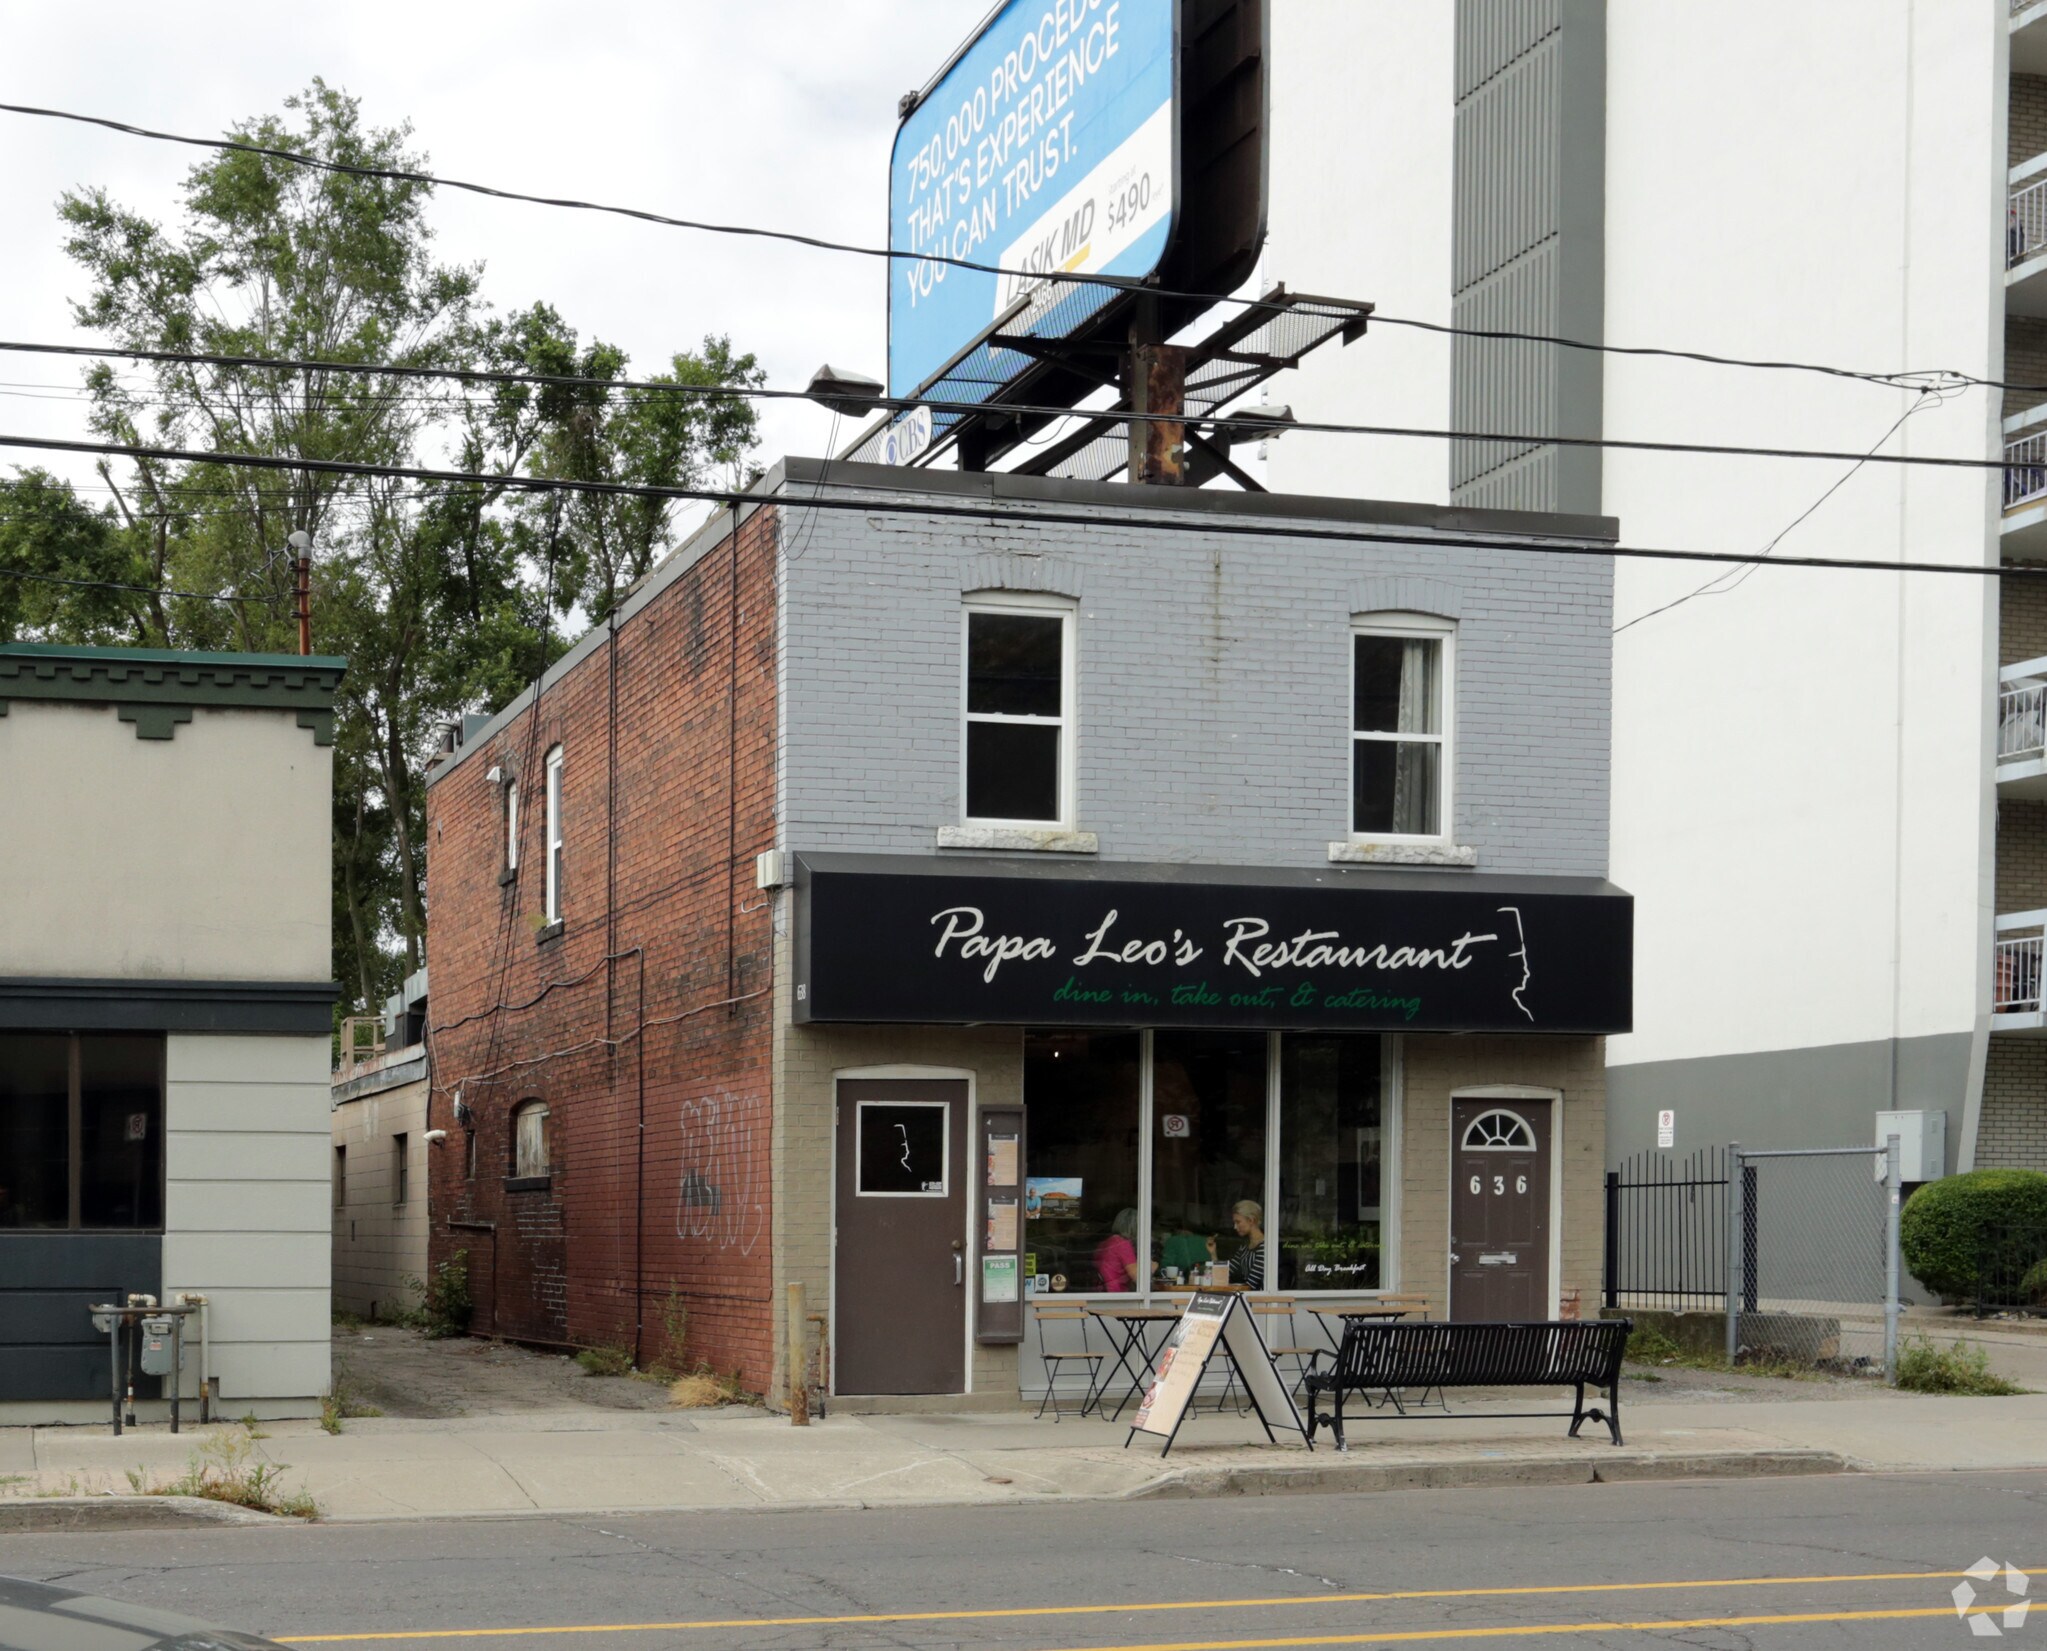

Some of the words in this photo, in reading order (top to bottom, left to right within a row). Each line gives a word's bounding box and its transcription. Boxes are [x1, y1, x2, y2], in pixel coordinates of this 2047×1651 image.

[908, 158, 971, 254] THAT'S
[977, 1, 1120, 189] EXPERIENCE
[908, 86, 986, 204] 750,000
[907, 236, 947, 308] YOU
[952, 187, 996, 261] CAN
[1002, 110, 1078, 218] TRUST.
[1108, 172, 1150, 234] $490
[1005, 228, 1058, 308] LASIK
[1060, 198, 1095, 261] MD
[899, 411, 926, 460] CBS
[930, 906, 1056, 984] Papa
[1072, 909, 1203, 966] Leo's
[1223, 917, 1498, 977] Restaurant
[1053, 976, 1113, 1003] dine
[1170, 981, 1222, 1006] take
[1290, 981, 1317, 1007] &
[1324, 986, 1422, 1021] catering
[1470, 1175, 1527, 1195] 636
[1305, 1264, 1317, 1272] All
[1317, 1264, 1332, 1276] Day
[1334, 1263, 1367, 1275] Breakfast
